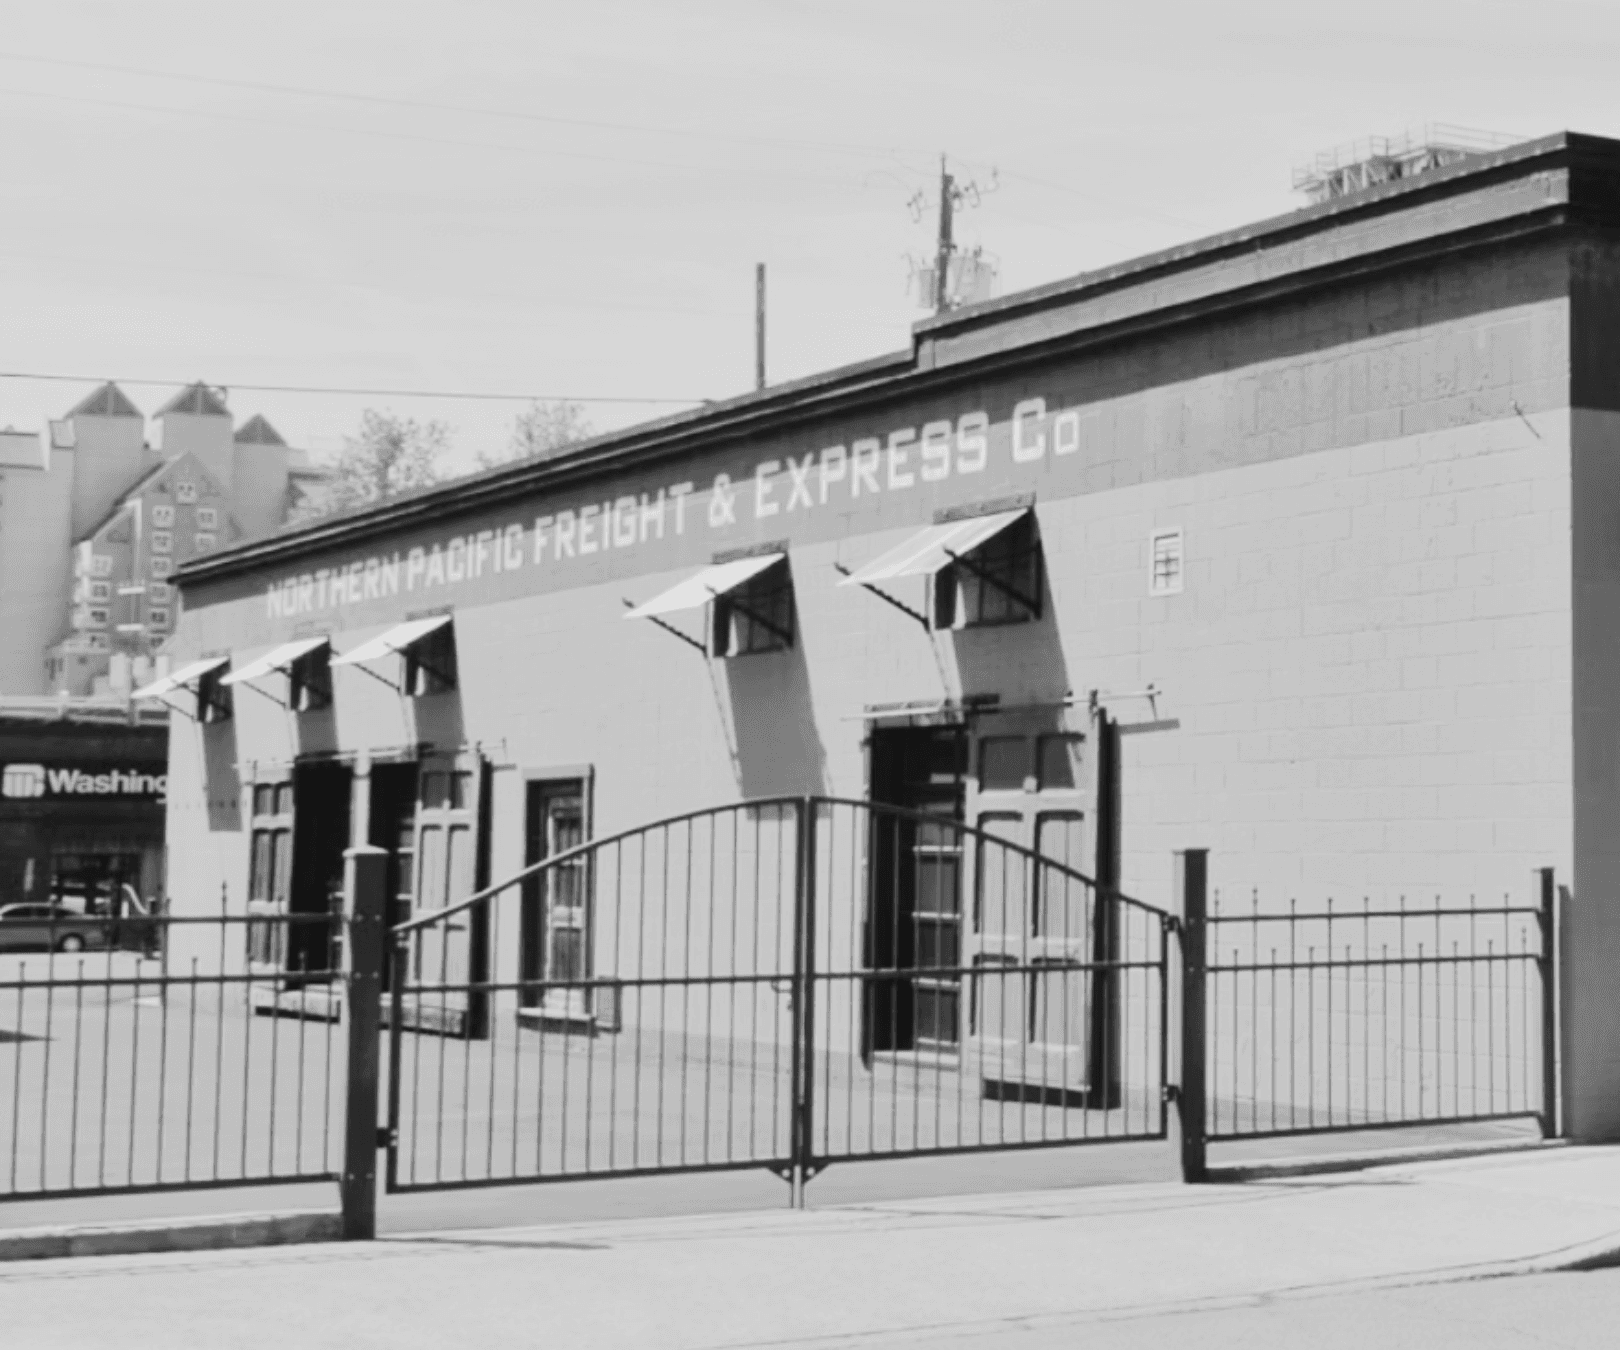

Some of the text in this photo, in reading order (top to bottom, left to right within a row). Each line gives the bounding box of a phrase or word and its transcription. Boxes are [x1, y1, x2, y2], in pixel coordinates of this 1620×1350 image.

[267, 397, 1080, 618] NORTHERN PACIFIC FREIGHT & EXPRESS Co
